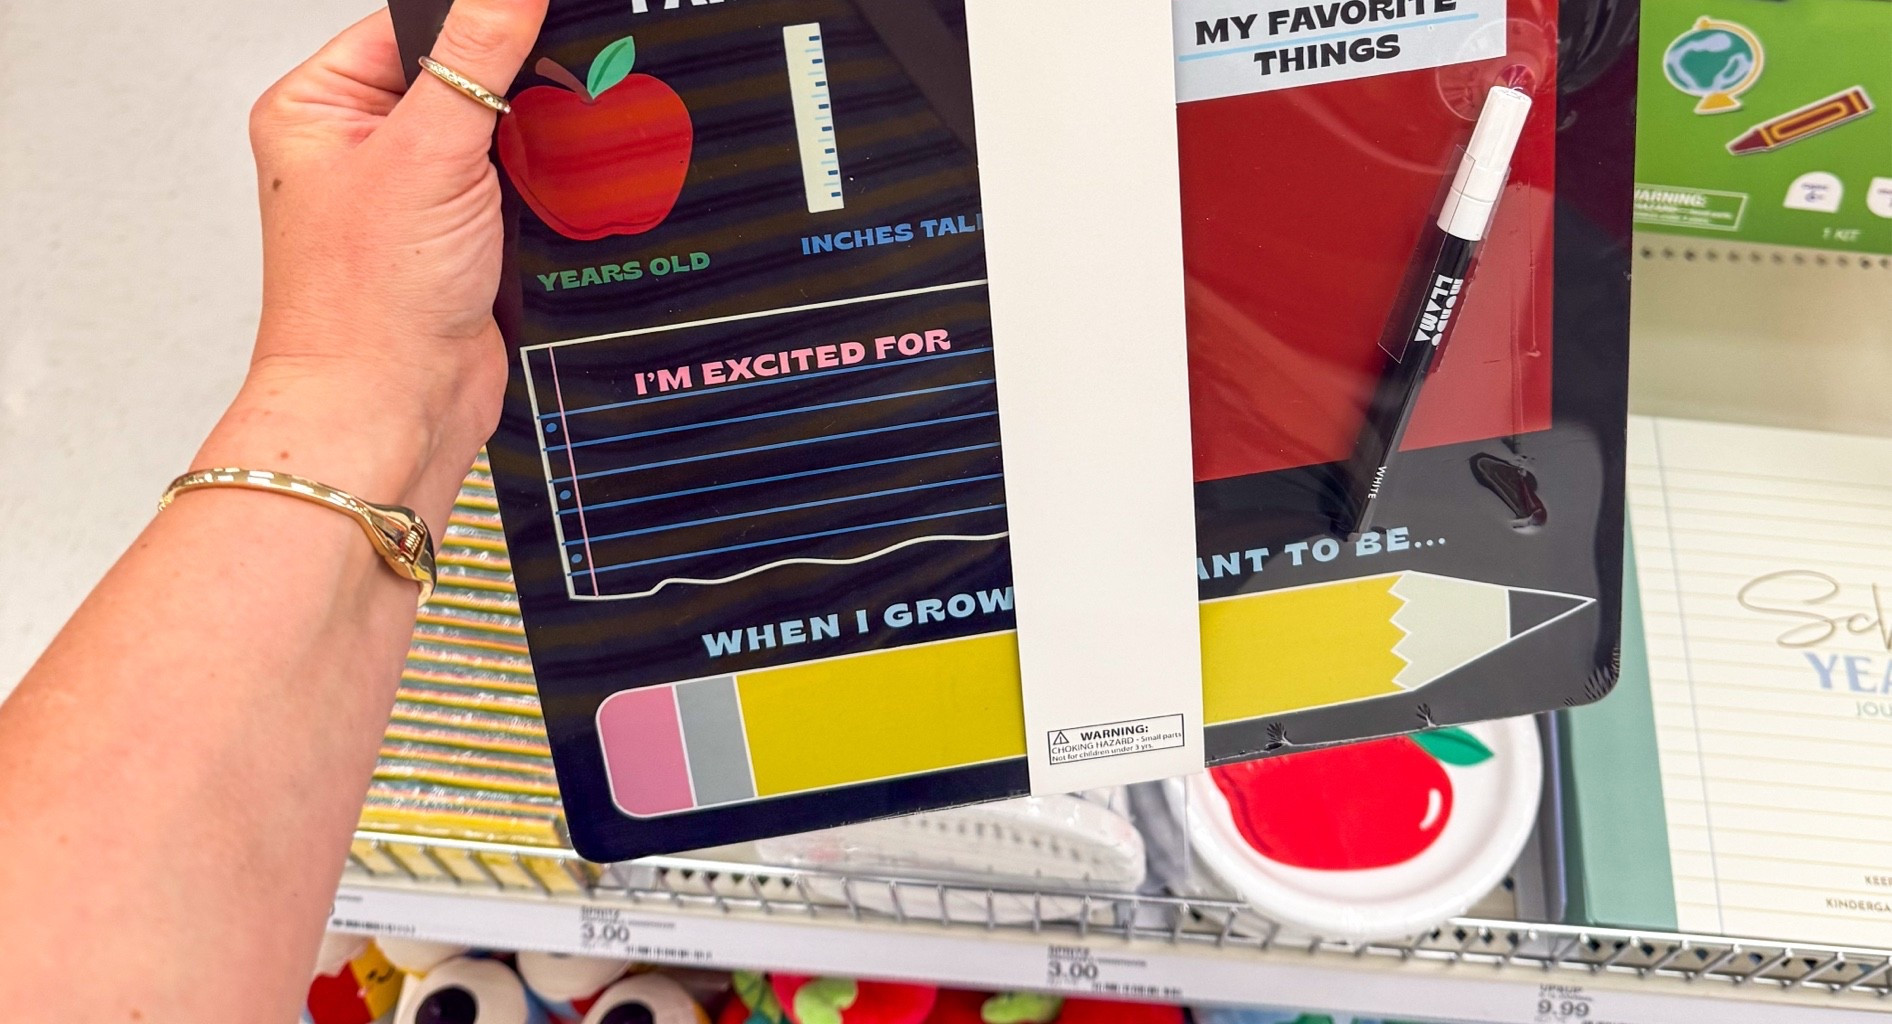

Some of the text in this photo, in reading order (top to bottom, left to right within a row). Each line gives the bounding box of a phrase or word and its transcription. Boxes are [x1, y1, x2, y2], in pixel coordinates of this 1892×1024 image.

[1195, 13, 1257, 46] MY
[1253, 33, 1401, 76] THINGS
[800, 223, 914, 255] INCHES
[537, 251, 711, 292] YEARS OLD
[701, 340, 866, 386] EXCITED
[875, 328, 951, 360] FOR
[1368, 466, 1388, 499] WHITE
[1284, 538, 1339, 566] TO
[701, 586, 1014, 658] WHEN I GROW
[1051, 741, 1094, 754] CHOKING
[1096, 736, 1134, 749] HAZARD
[1140, 733, 1161, 742] Small
[1080, 725, 1148, 741] WARNING:
[1067, 753, 1078, 761] for
[1079, 749, 1110, 758] children
[1111, 746, 1133, 754] under
[582, 922, 630, 942] 3.00
[1048, 960, 1098, 979] 3.00
[1537, 999, 1590, 1017] 9.99
